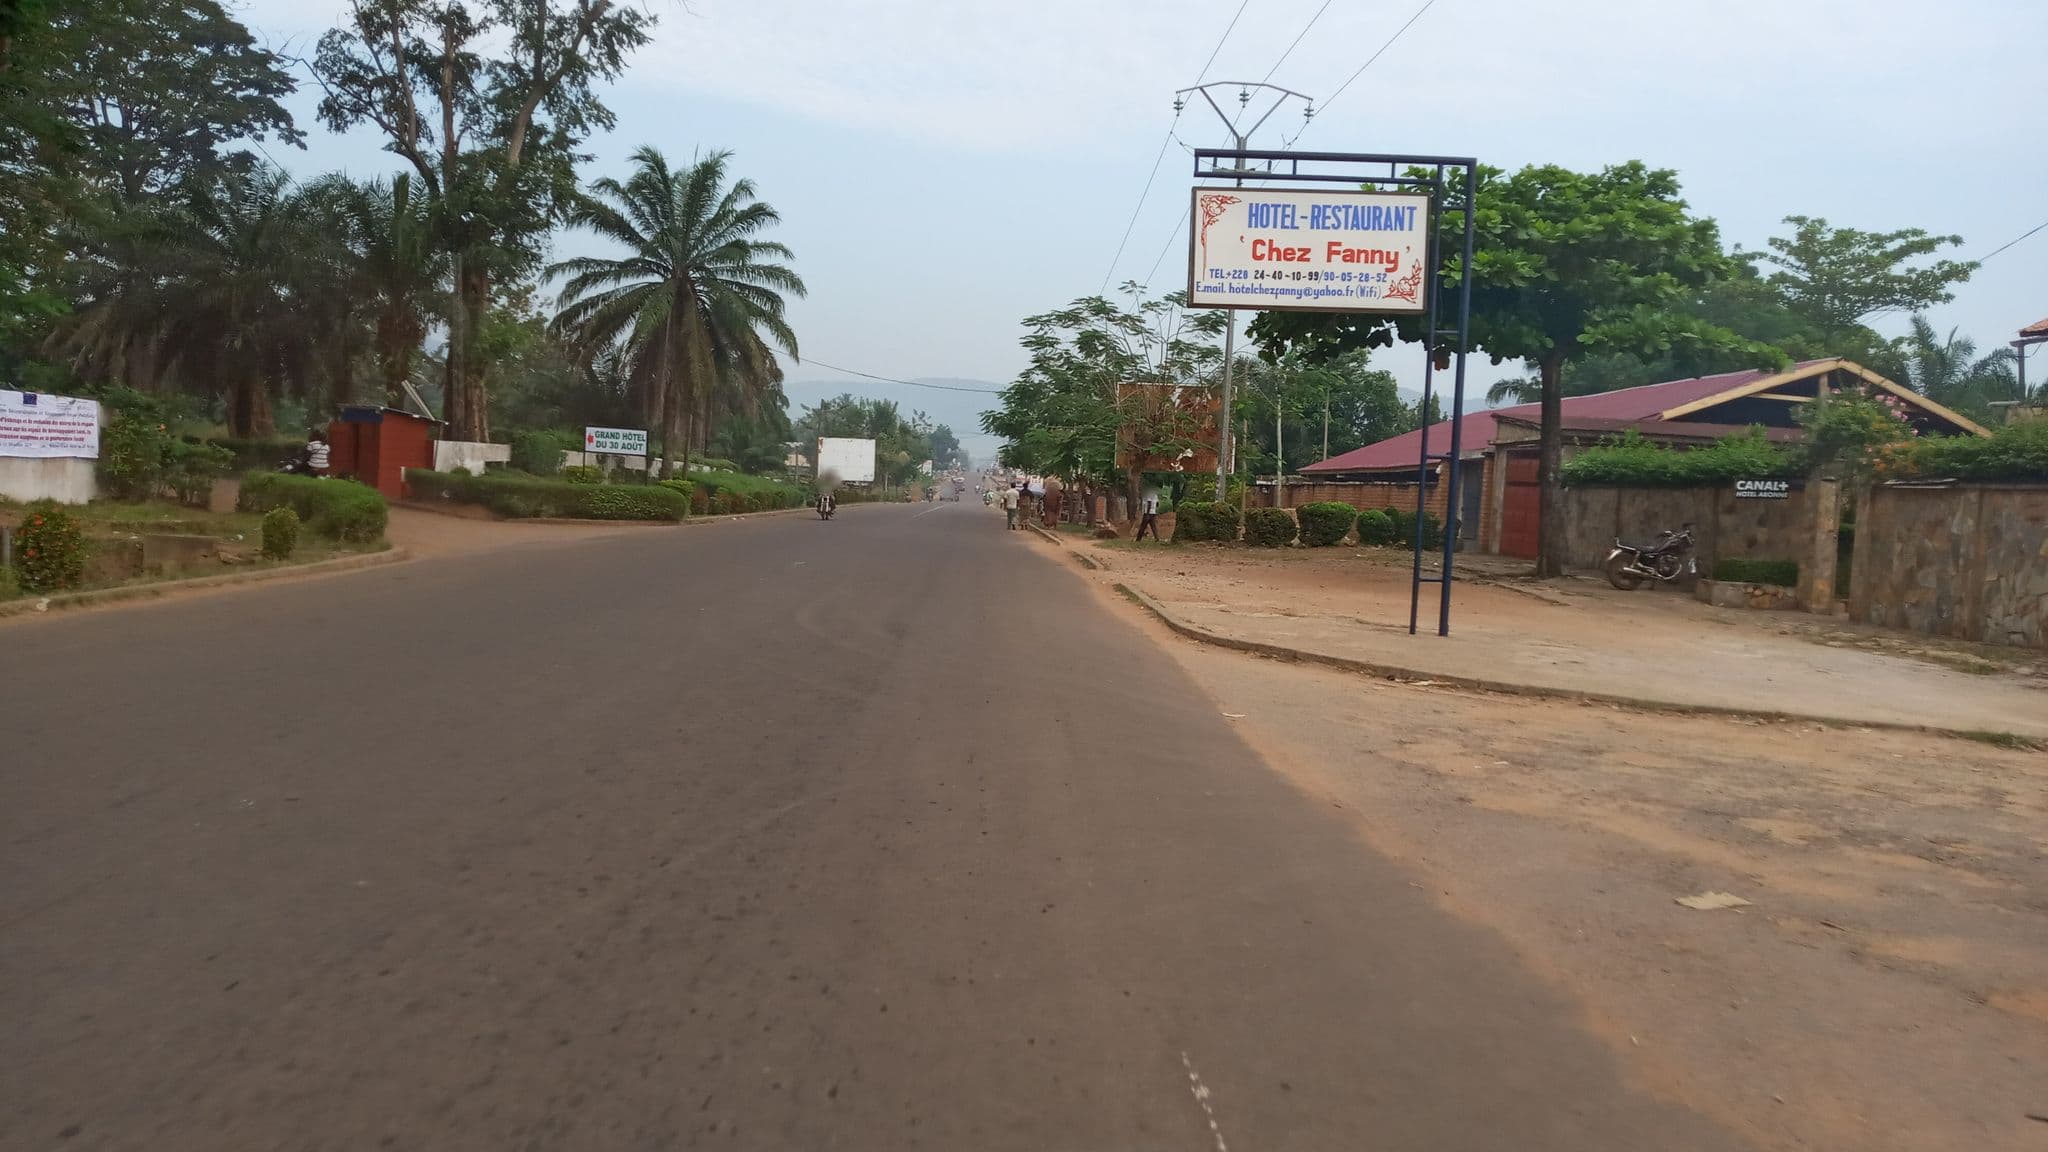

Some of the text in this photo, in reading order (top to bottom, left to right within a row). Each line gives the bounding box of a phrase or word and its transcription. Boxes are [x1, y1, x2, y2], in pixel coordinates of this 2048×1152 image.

[1247, 202, 1418, 231] HOTEL-RESTAURANT
[1355, 284, 1382, 299] (Wifi)
[595, 431, 620, 440] GRAND
[596, 441, 607, 449] DU
[609, 441, 618, 449] 30
[1737, 480, 1789, 491] CANAL+
